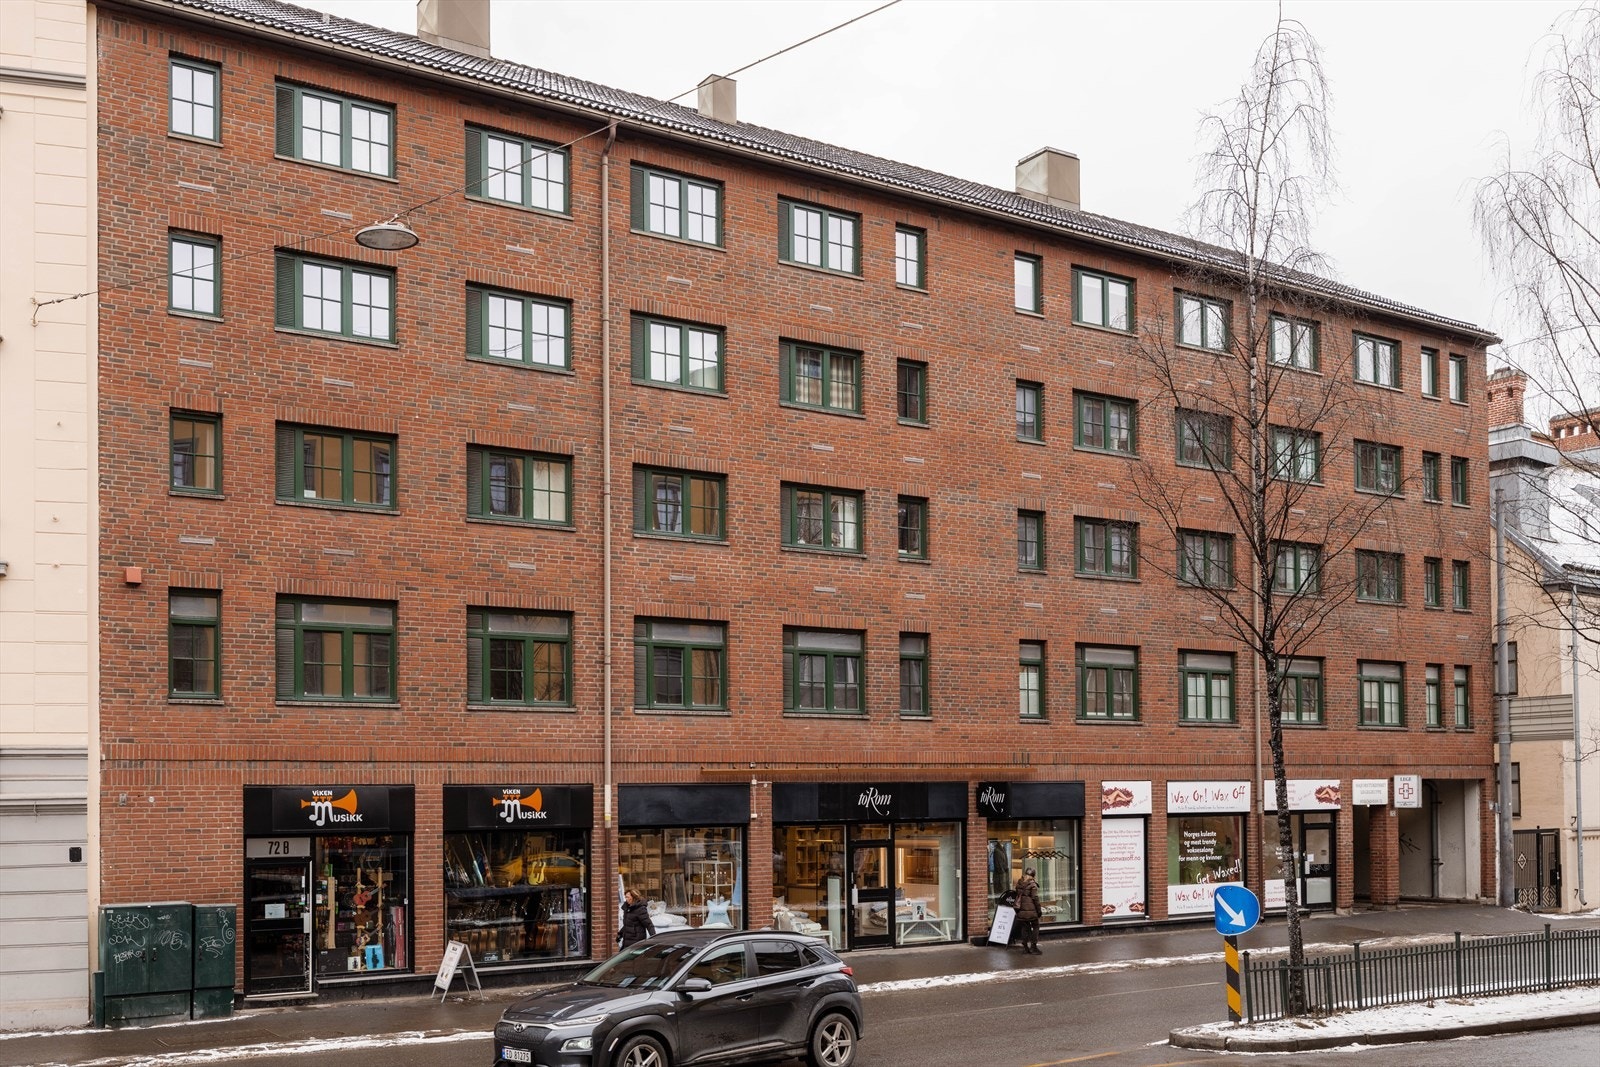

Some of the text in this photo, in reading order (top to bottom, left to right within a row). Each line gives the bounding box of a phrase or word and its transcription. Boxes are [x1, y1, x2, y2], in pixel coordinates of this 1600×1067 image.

[1171, 790, 1189, 804] Wax
[1211, 789, 1229, 802] Wax
[1232, 785, 1246, 803] Off
[1183, 831, 1200, 839] Norges
[1202, 838, 1217, 846] trendy
[268, 841, 289, 855] 72 B
[1187, 846, 1214, 855] voksesalong
[1196, 858, 1242, 884] Get Waxed!
[1174, 890, 1190, 902] Wax
[506, 1050, 530, 1061] ED 81275
